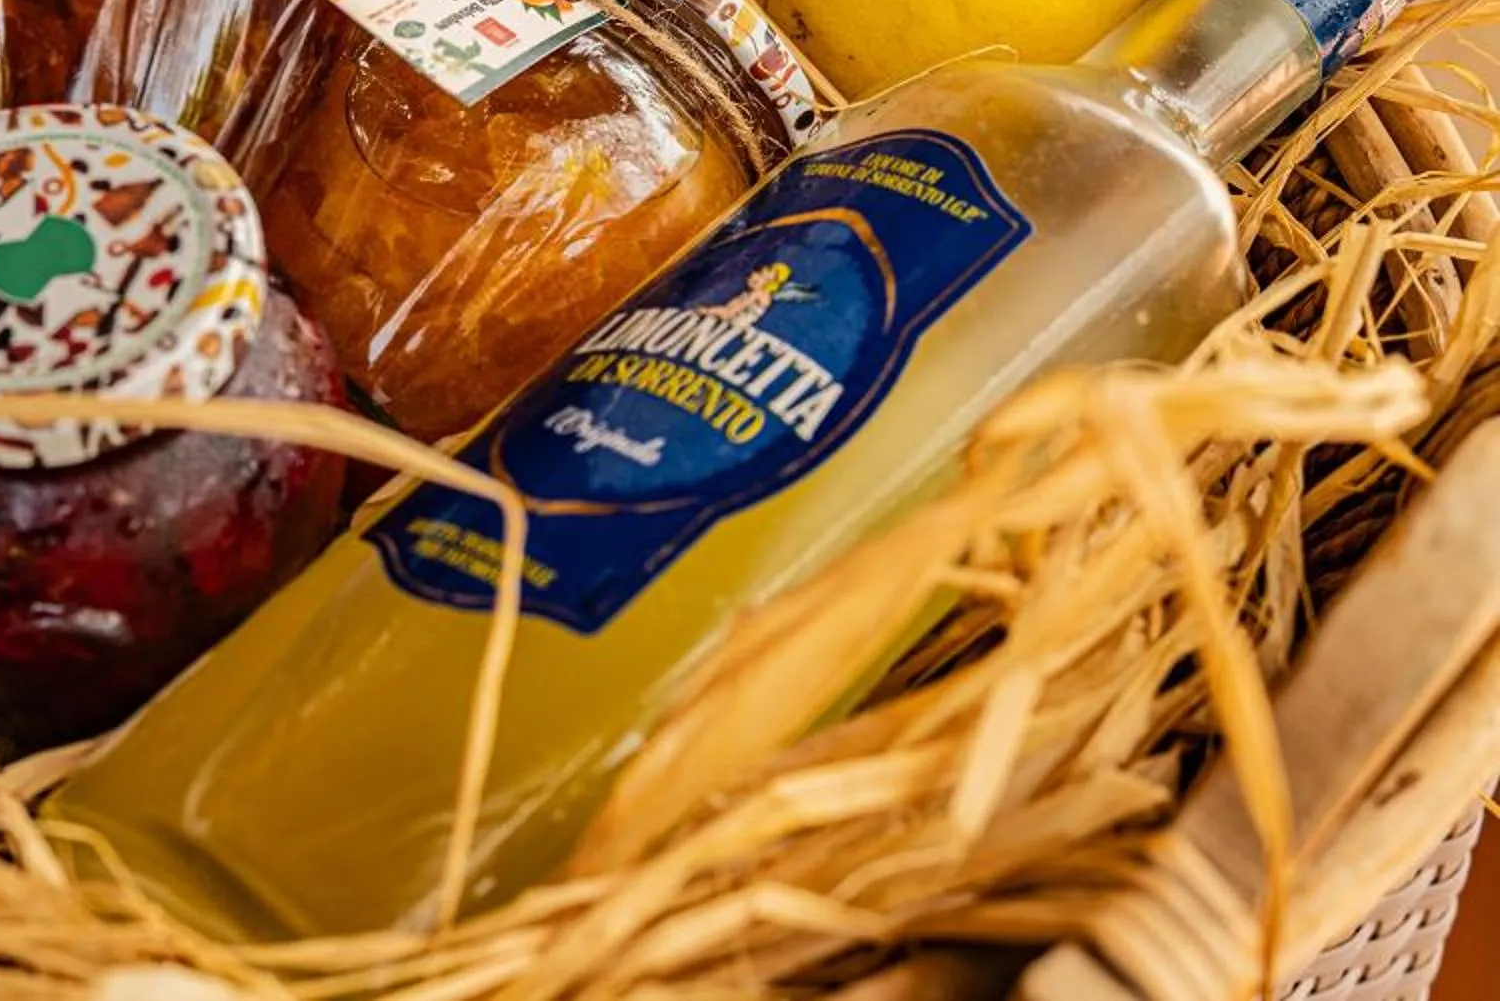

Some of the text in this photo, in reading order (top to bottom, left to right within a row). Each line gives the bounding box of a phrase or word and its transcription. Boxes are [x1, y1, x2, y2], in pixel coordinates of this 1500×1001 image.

[567, 354, 766, 445] DI SORRENTO
[574, 308, 844, 441] LIMONCETTA
